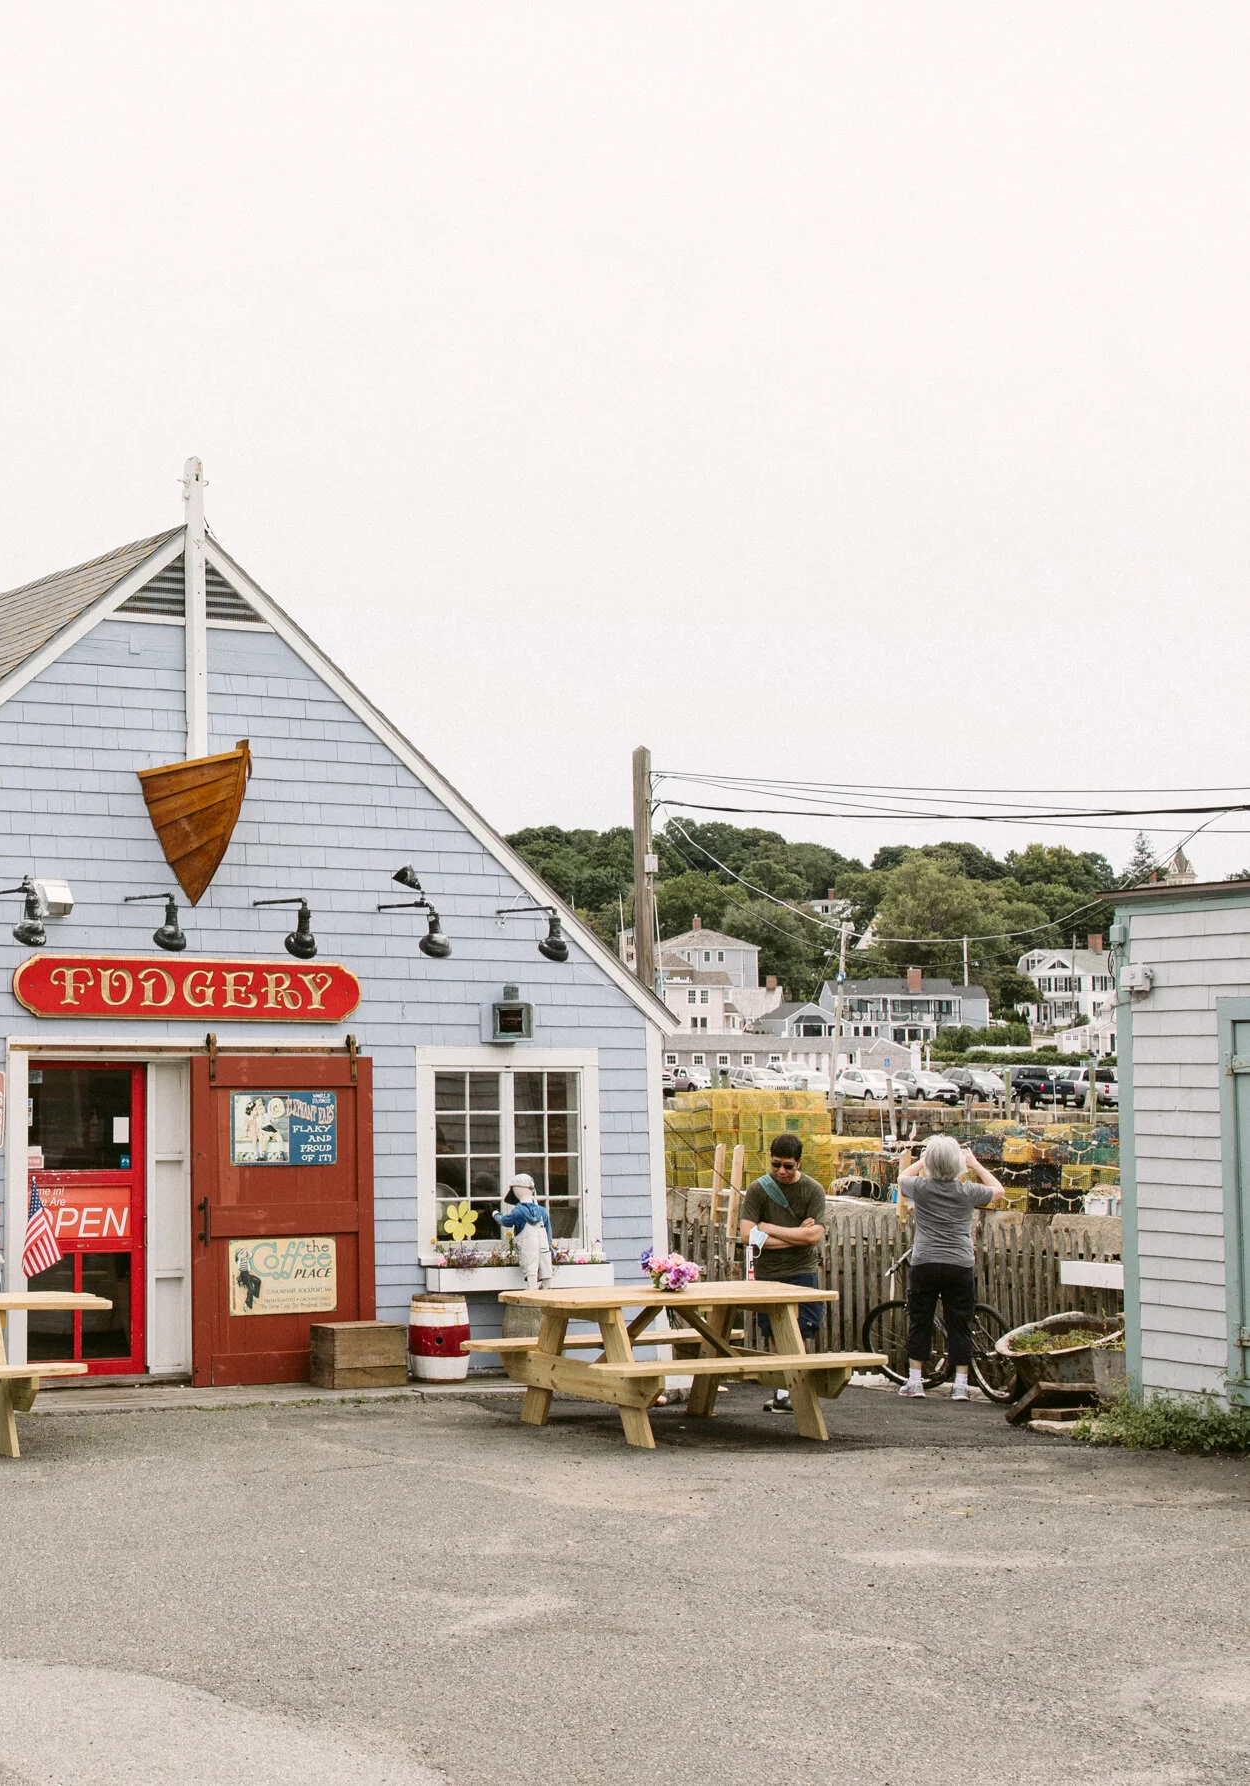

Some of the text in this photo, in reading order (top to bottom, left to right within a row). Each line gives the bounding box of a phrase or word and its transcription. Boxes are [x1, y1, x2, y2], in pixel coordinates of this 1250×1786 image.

[50, 966, 333, 1010] FUDGERY
[292, 1124, 332, 1133] FLAKY
[307, 1134, 332, 1143] AND
[300, 1144, 332, 1153] PROUD
[301, 1154, 315, 1162] OF
[53, 1186, 65, 1196] in!
[49, 1197, 66, 1207] Are
[306, 1240, 330, 1253] the
[250, 1241, 333, 1280] Coffee
[294, 1267, 333, 1279] PLACE
